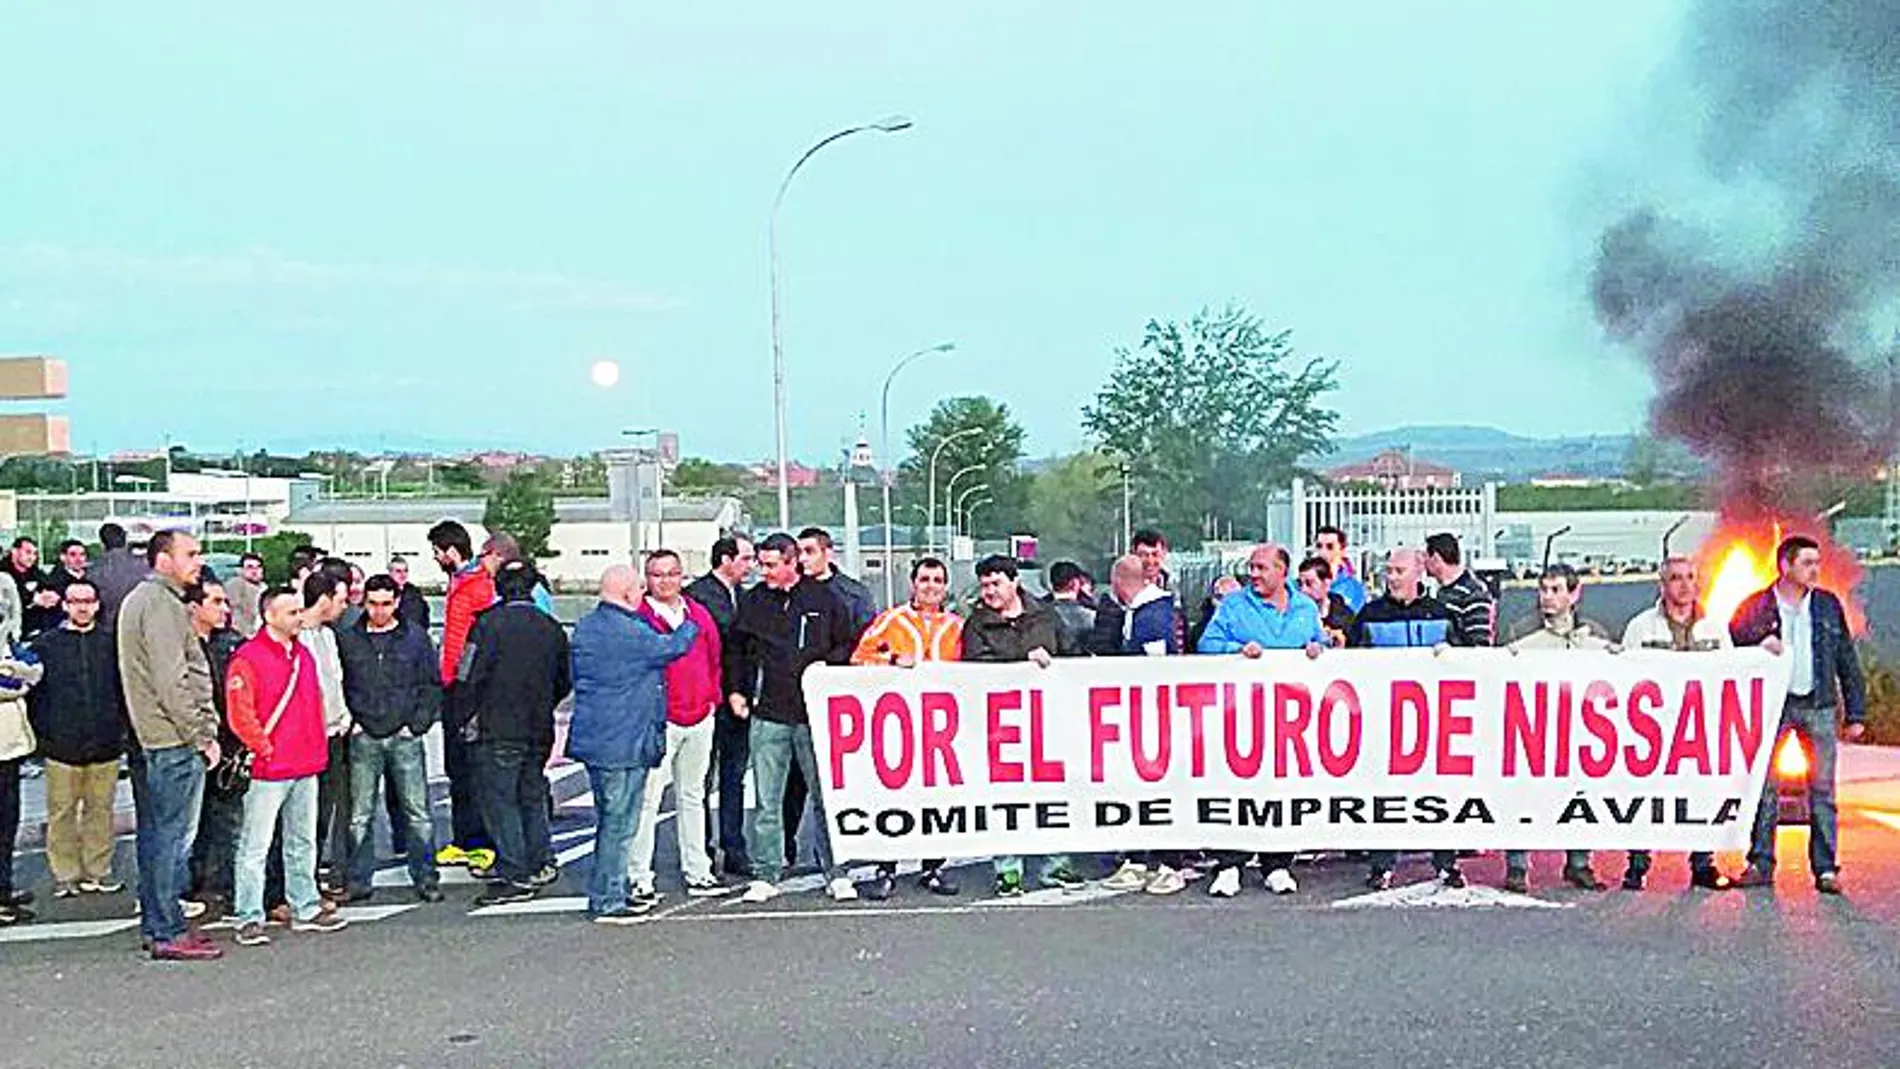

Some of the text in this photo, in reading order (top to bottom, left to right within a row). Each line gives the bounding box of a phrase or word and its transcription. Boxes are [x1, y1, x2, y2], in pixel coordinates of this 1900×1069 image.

[828, 678, 1764, 791] POR EL FUTURO DE NISSAN
[835, 802, 1070, 838] COMITE
[1095, 798, 1173, 828] DE
[1198, 796, 1495, 826] EMPRESA
[1557, 791, 1743, 826] ÁVILA
